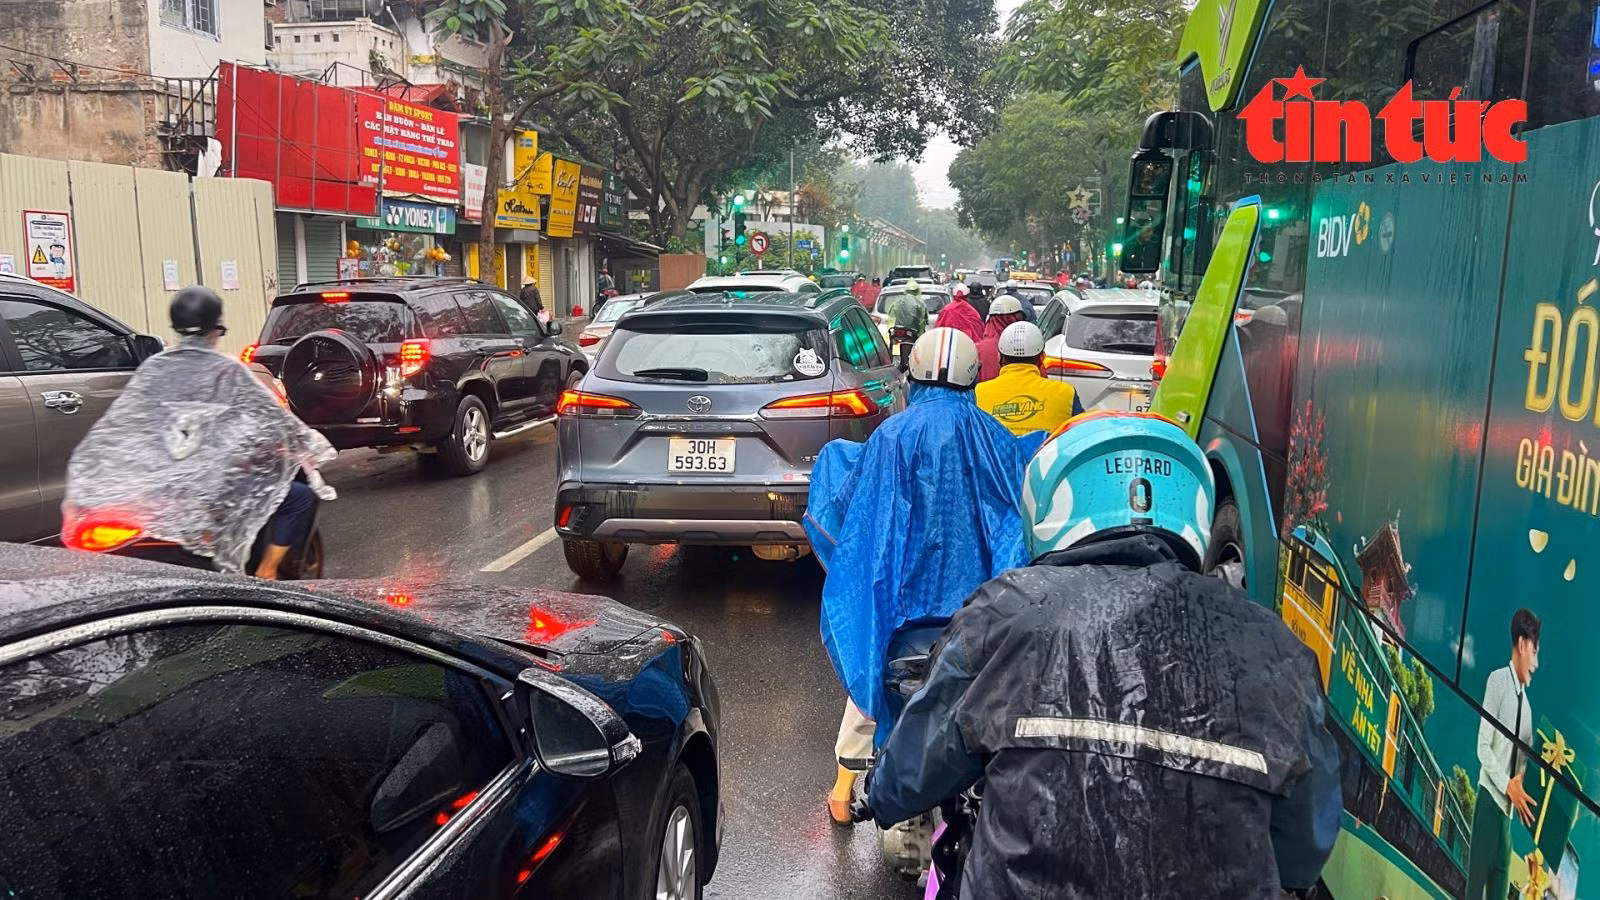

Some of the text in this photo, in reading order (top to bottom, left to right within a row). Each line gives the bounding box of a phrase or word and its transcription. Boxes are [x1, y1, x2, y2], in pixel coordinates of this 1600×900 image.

[404, 207, 434, 228] YONEX
[1317, 213, 1356, 258] BIDV
[1524, 278, 1600, 427] ĐÓ
[687, 440, 716, 455] 30H
[674, 456, 727, 471] 593.63
[1104, 458, 1171, 477] LEOPARD
[1515, 437, 1554, 498] GIA
